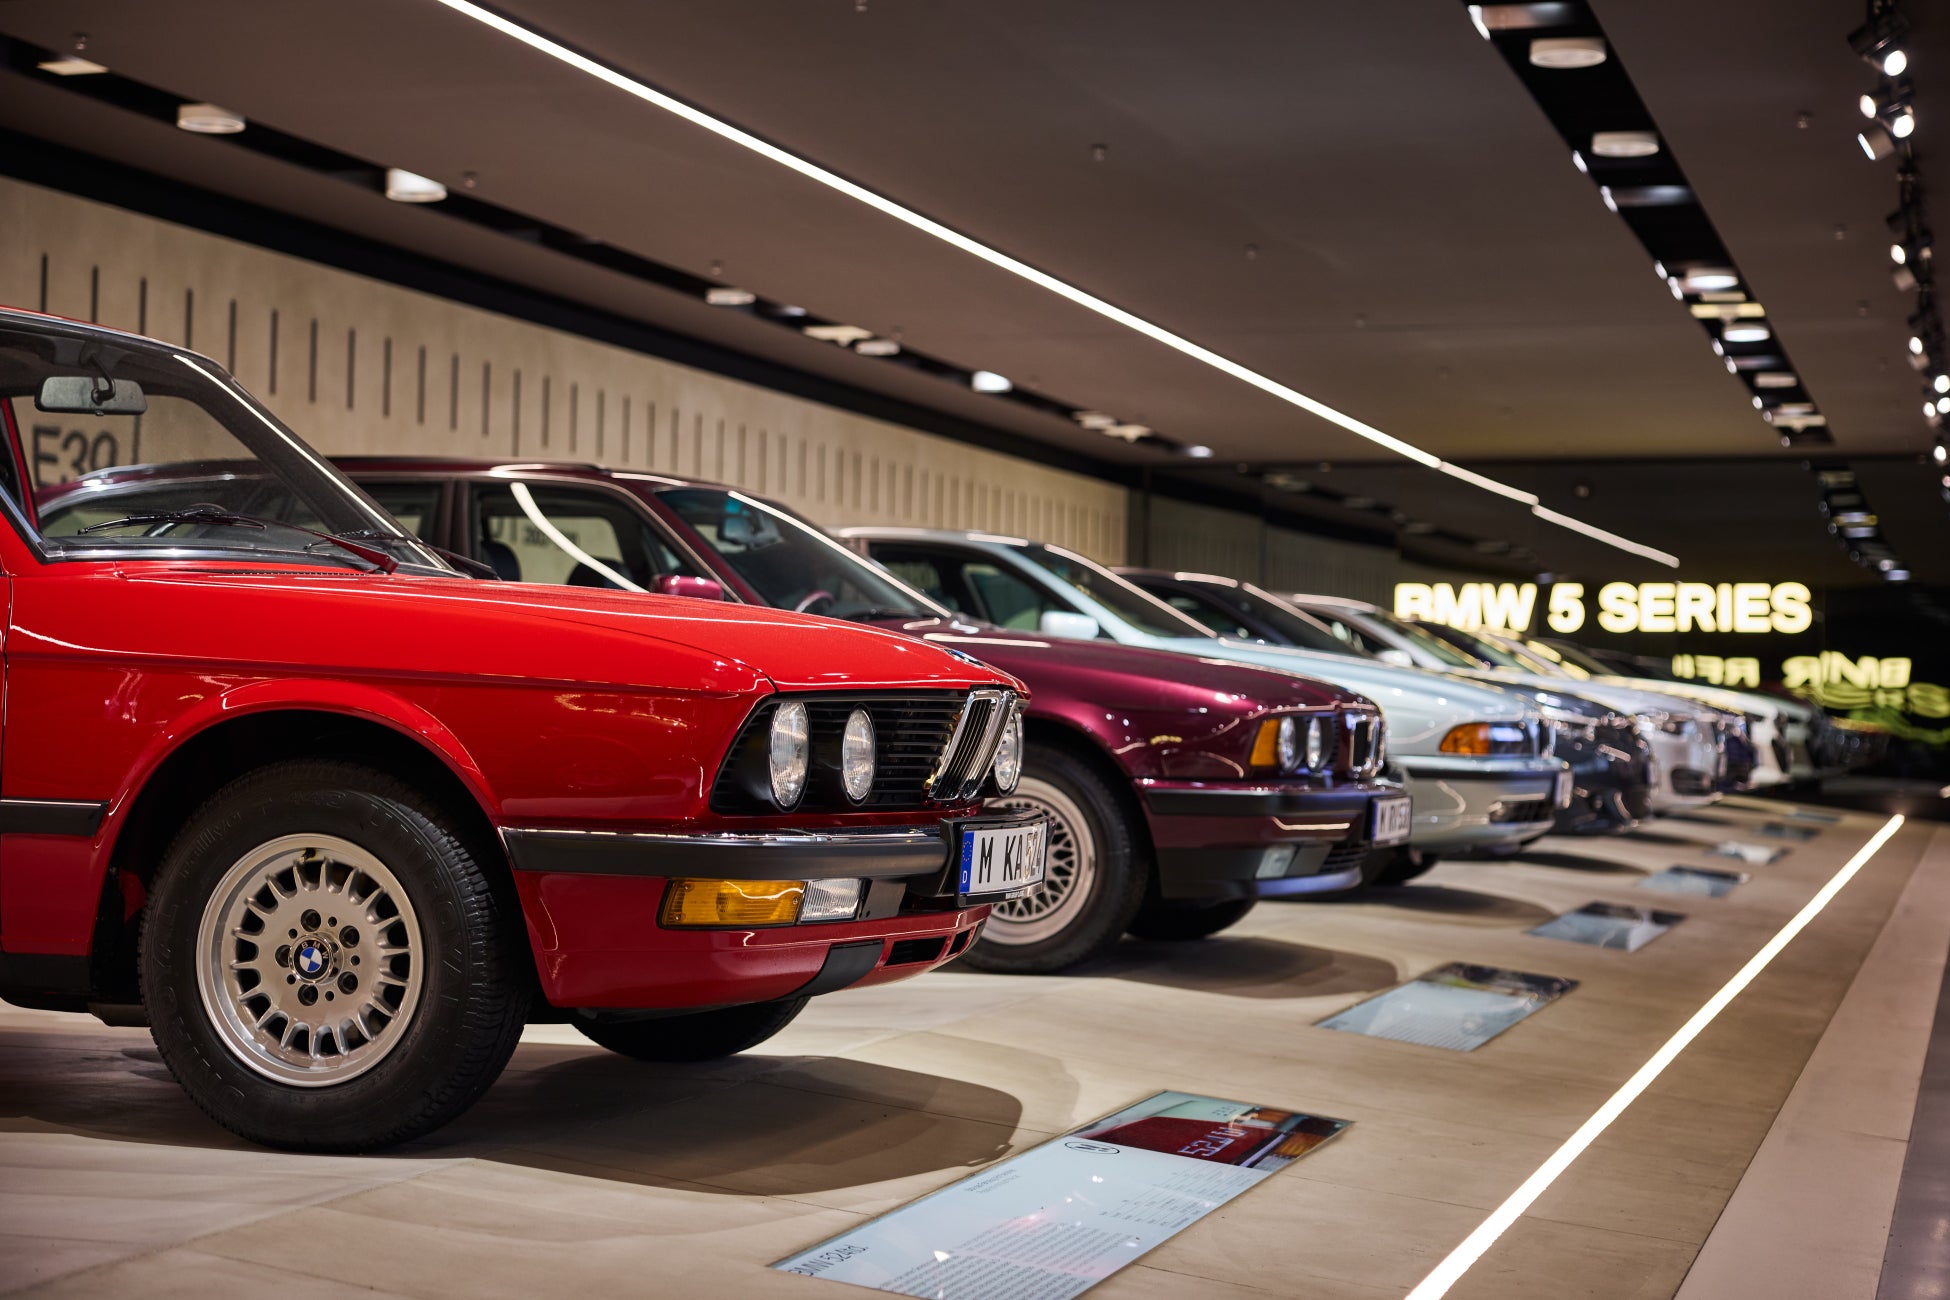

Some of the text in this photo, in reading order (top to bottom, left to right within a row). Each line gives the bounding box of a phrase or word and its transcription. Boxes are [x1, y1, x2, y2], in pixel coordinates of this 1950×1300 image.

[1394, 581, 1812, 633] BMW 5 SERIES
[962, 870, 968, 884] D
[978, 836, 994, 884] M
[301, 941, 329, 959] BMW
